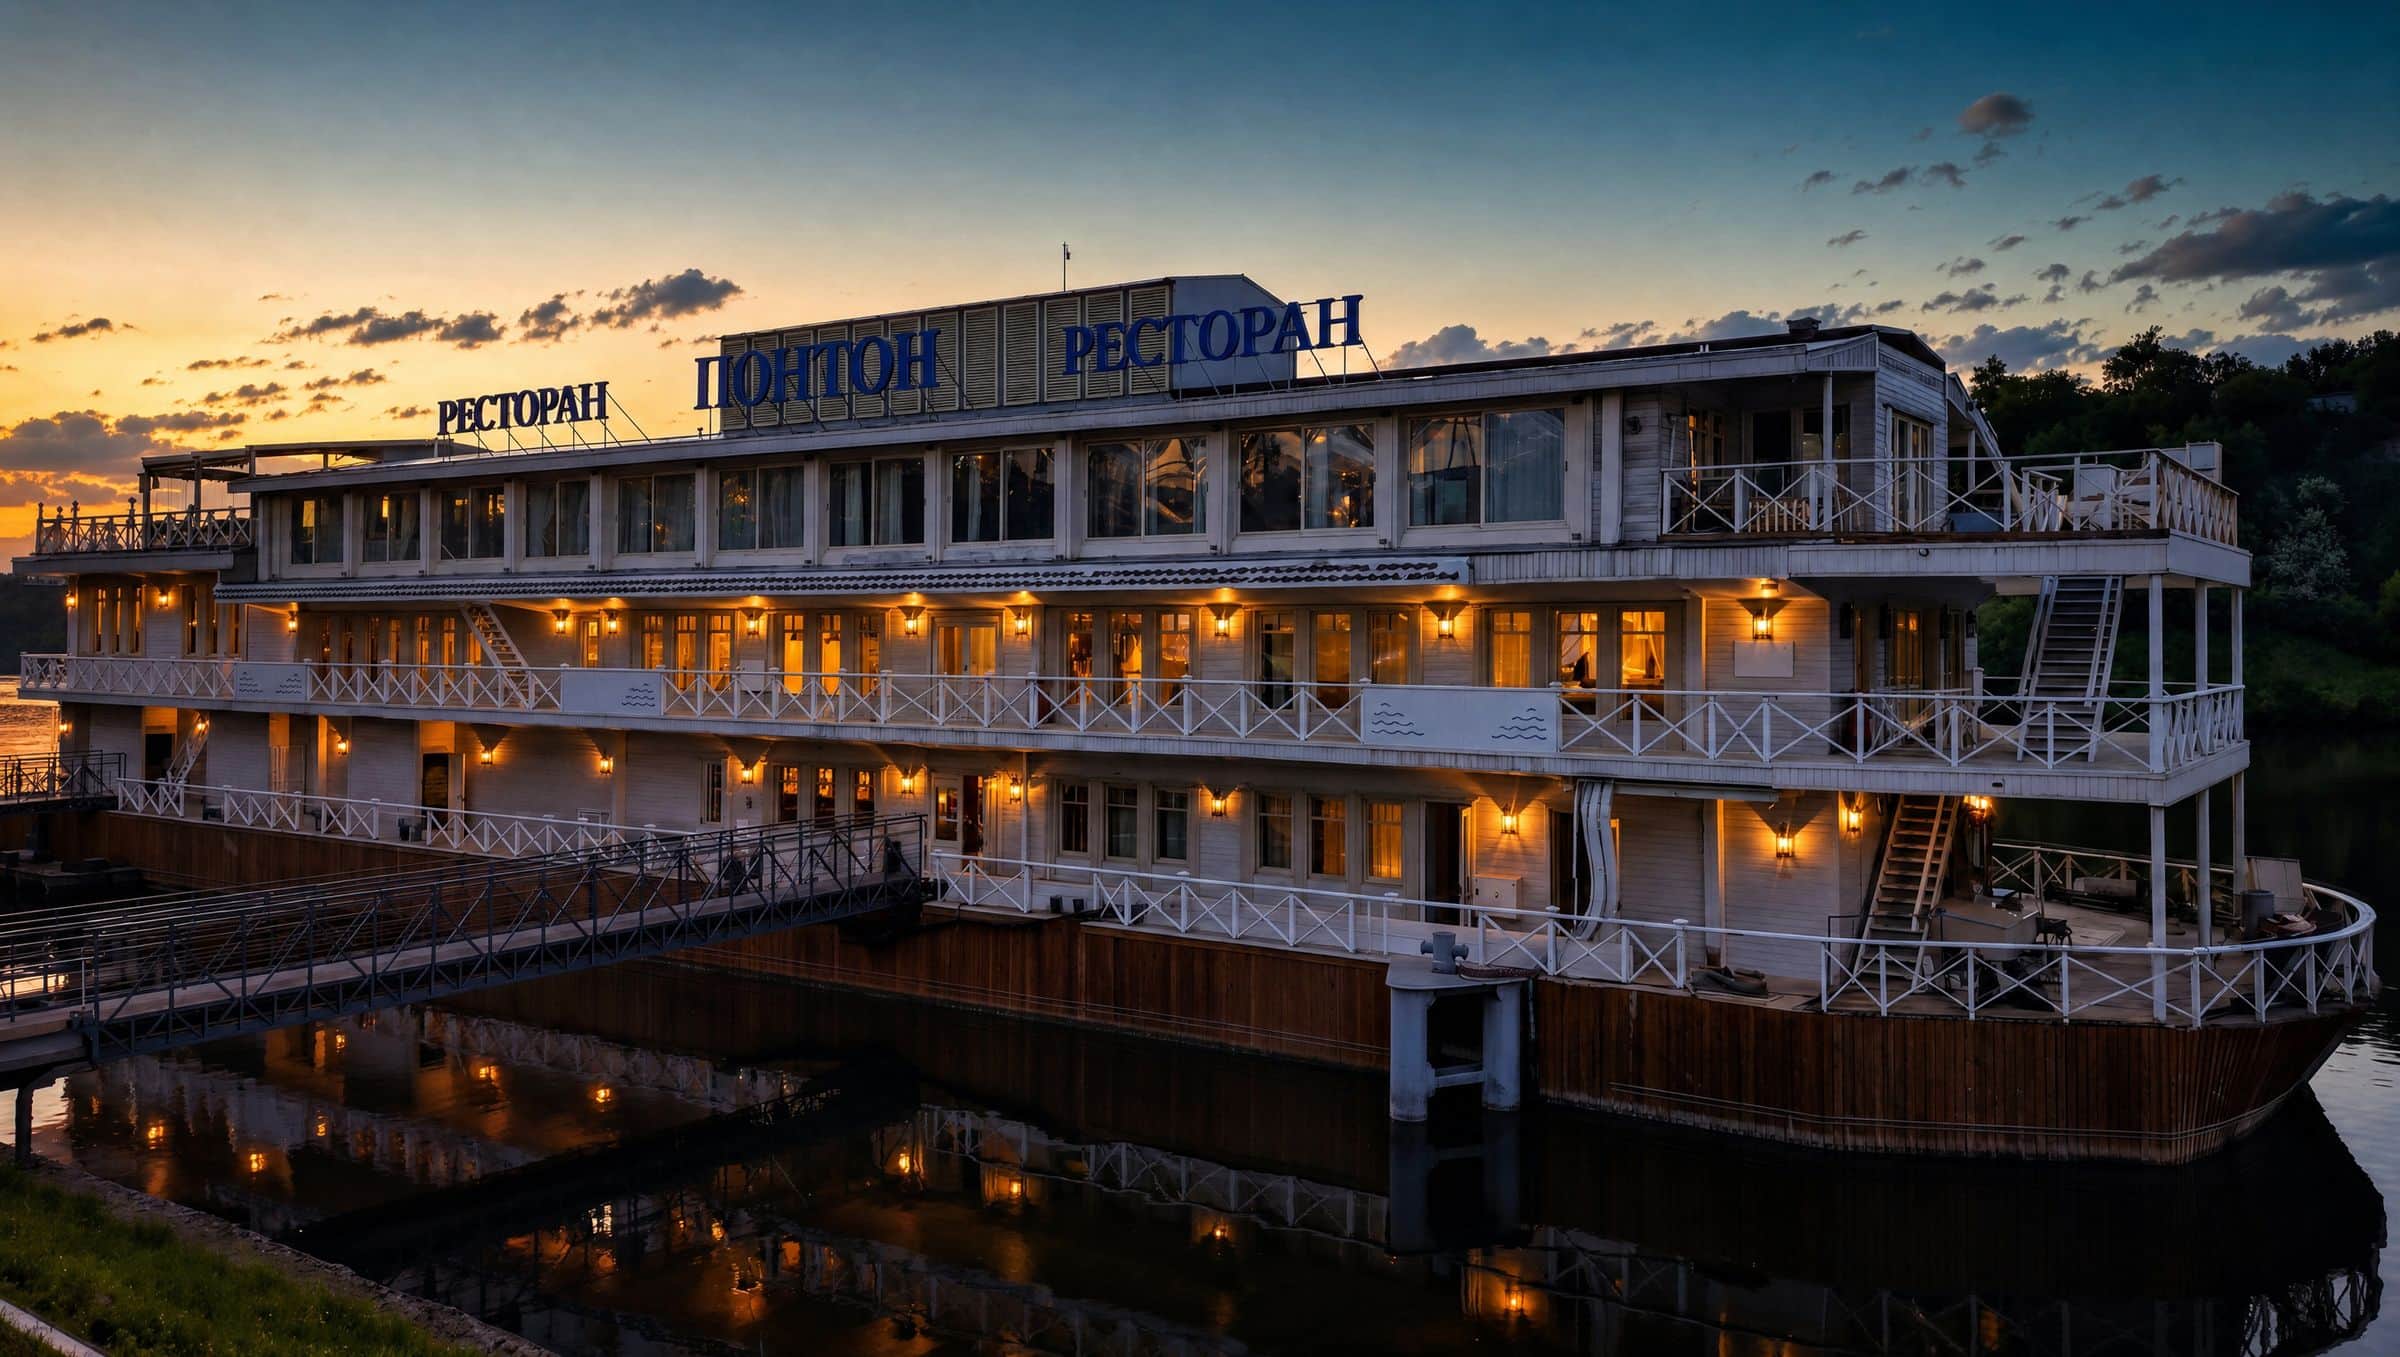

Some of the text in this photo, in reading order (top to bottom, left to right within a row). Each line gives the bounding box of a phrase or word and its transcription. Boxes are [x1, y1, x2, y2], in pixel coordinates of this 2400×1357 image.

[694, 294, 1363, 410] ПОНТОН РЕСТОРАН
[438, 381, 609, 435] РЕСТОРАН
